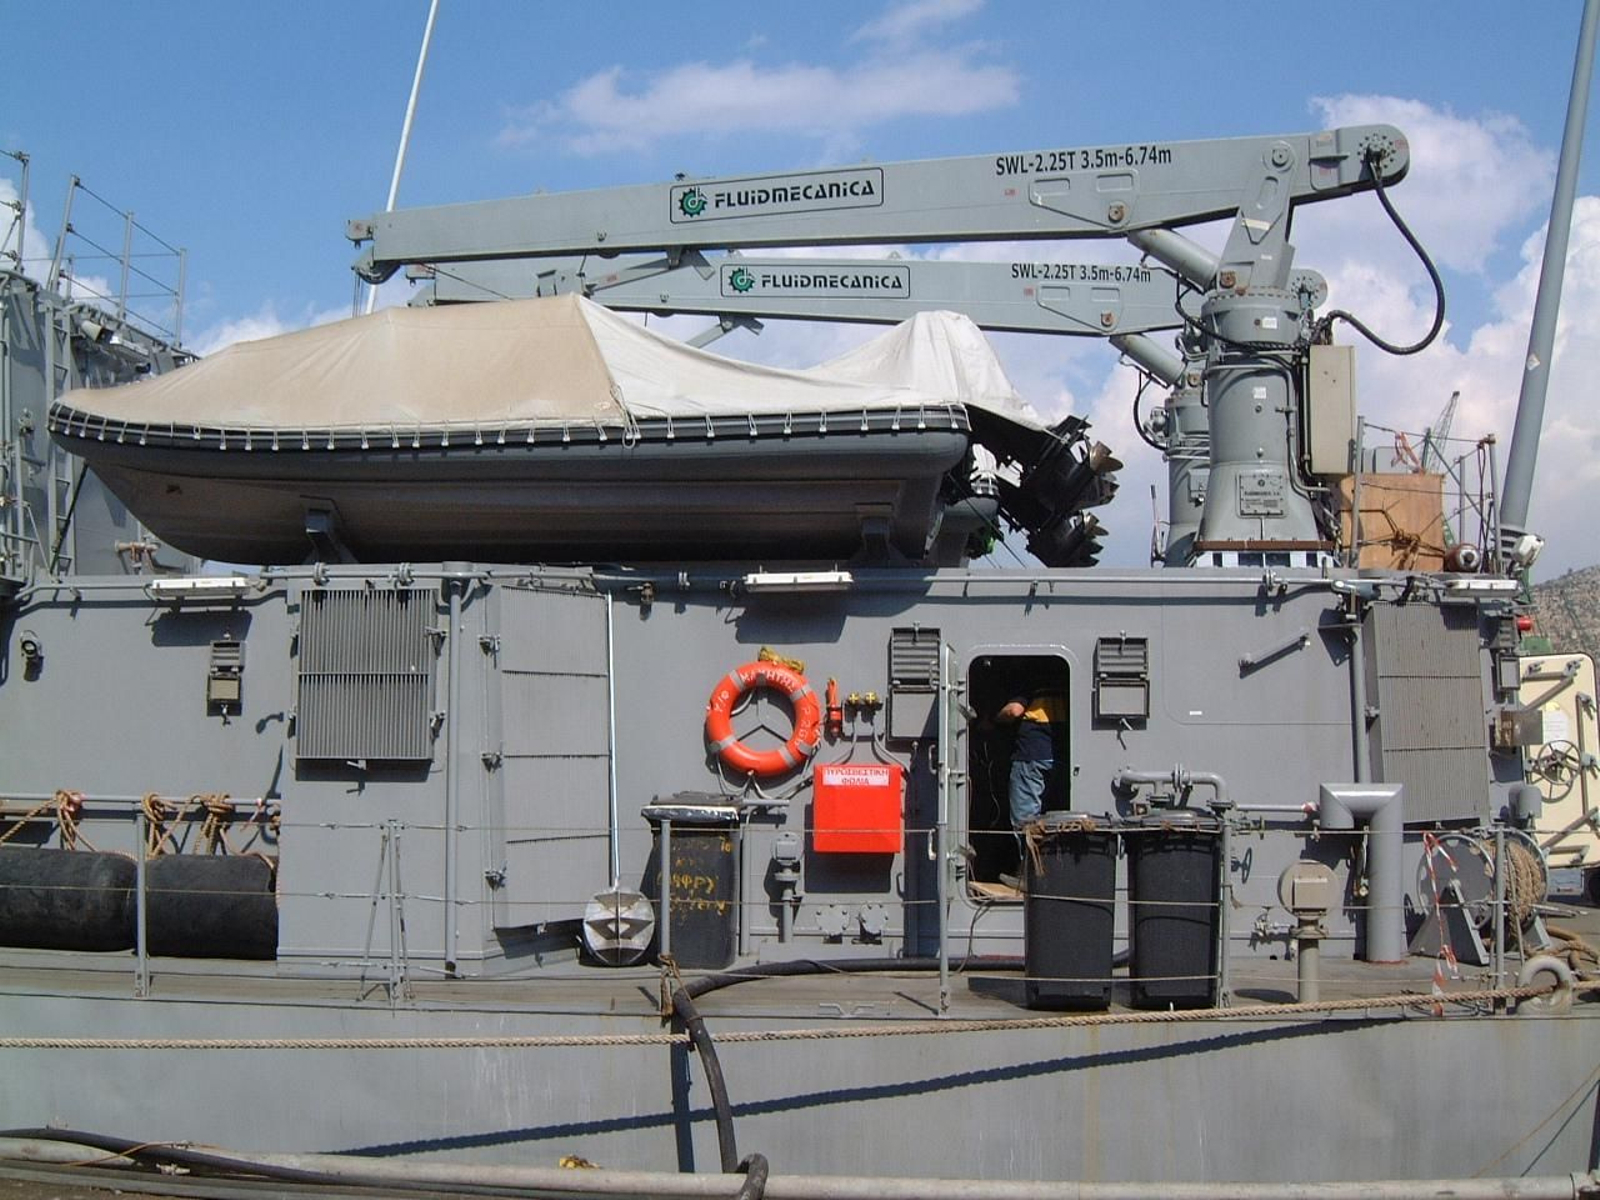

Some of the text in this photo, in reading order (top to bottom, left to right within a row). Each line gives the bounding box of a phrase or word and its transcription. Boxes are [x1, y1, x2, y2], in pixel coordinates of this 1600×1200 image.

[996, 146, 1172, 175] SWL-2.25T 3.5m-6.74m
[1011, 263, 1151, 282] SWL-2.25T 3.5m-6.74m
